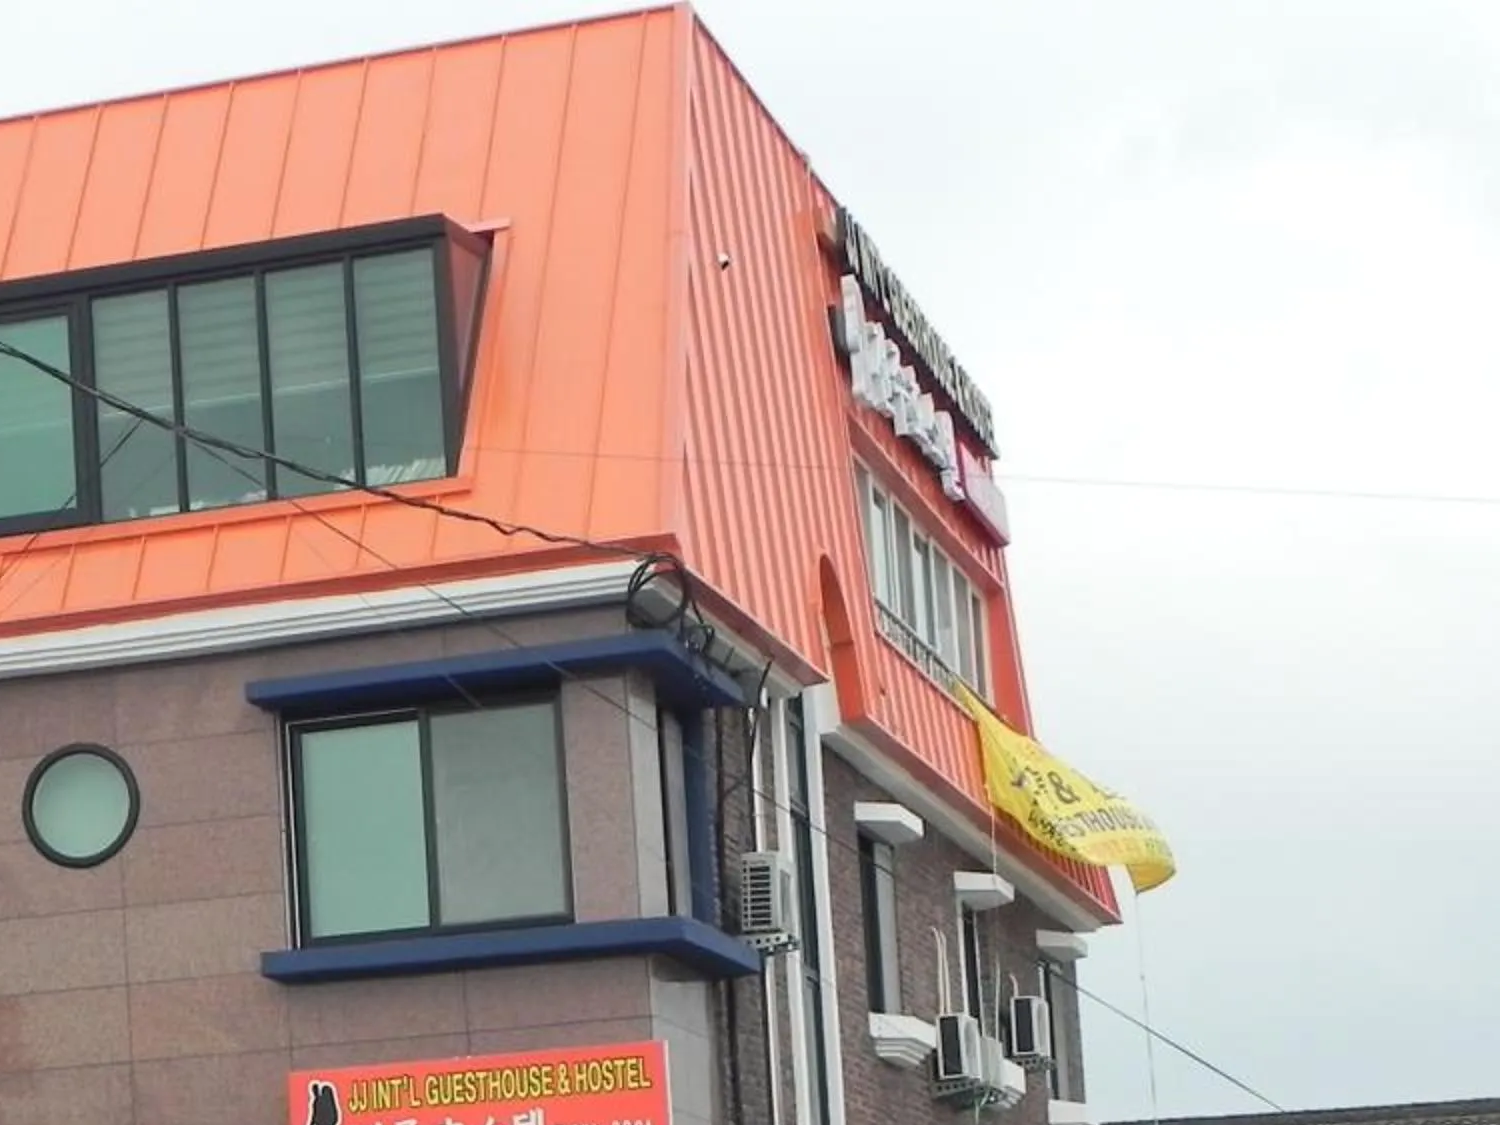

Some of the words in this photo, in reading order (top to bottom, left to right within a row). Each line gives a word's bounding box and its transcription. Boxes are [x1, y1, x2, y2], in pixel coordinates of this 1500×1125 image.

[348, 1080, 368, 1112] JJ
[372, 1075, 422, 1109] INT'L
[424, 1065, 554, 1106] GUESTHOUSE
[557, 1062, 572, 1095] &
[574, 1057, 652, 1092] HOSTEL
